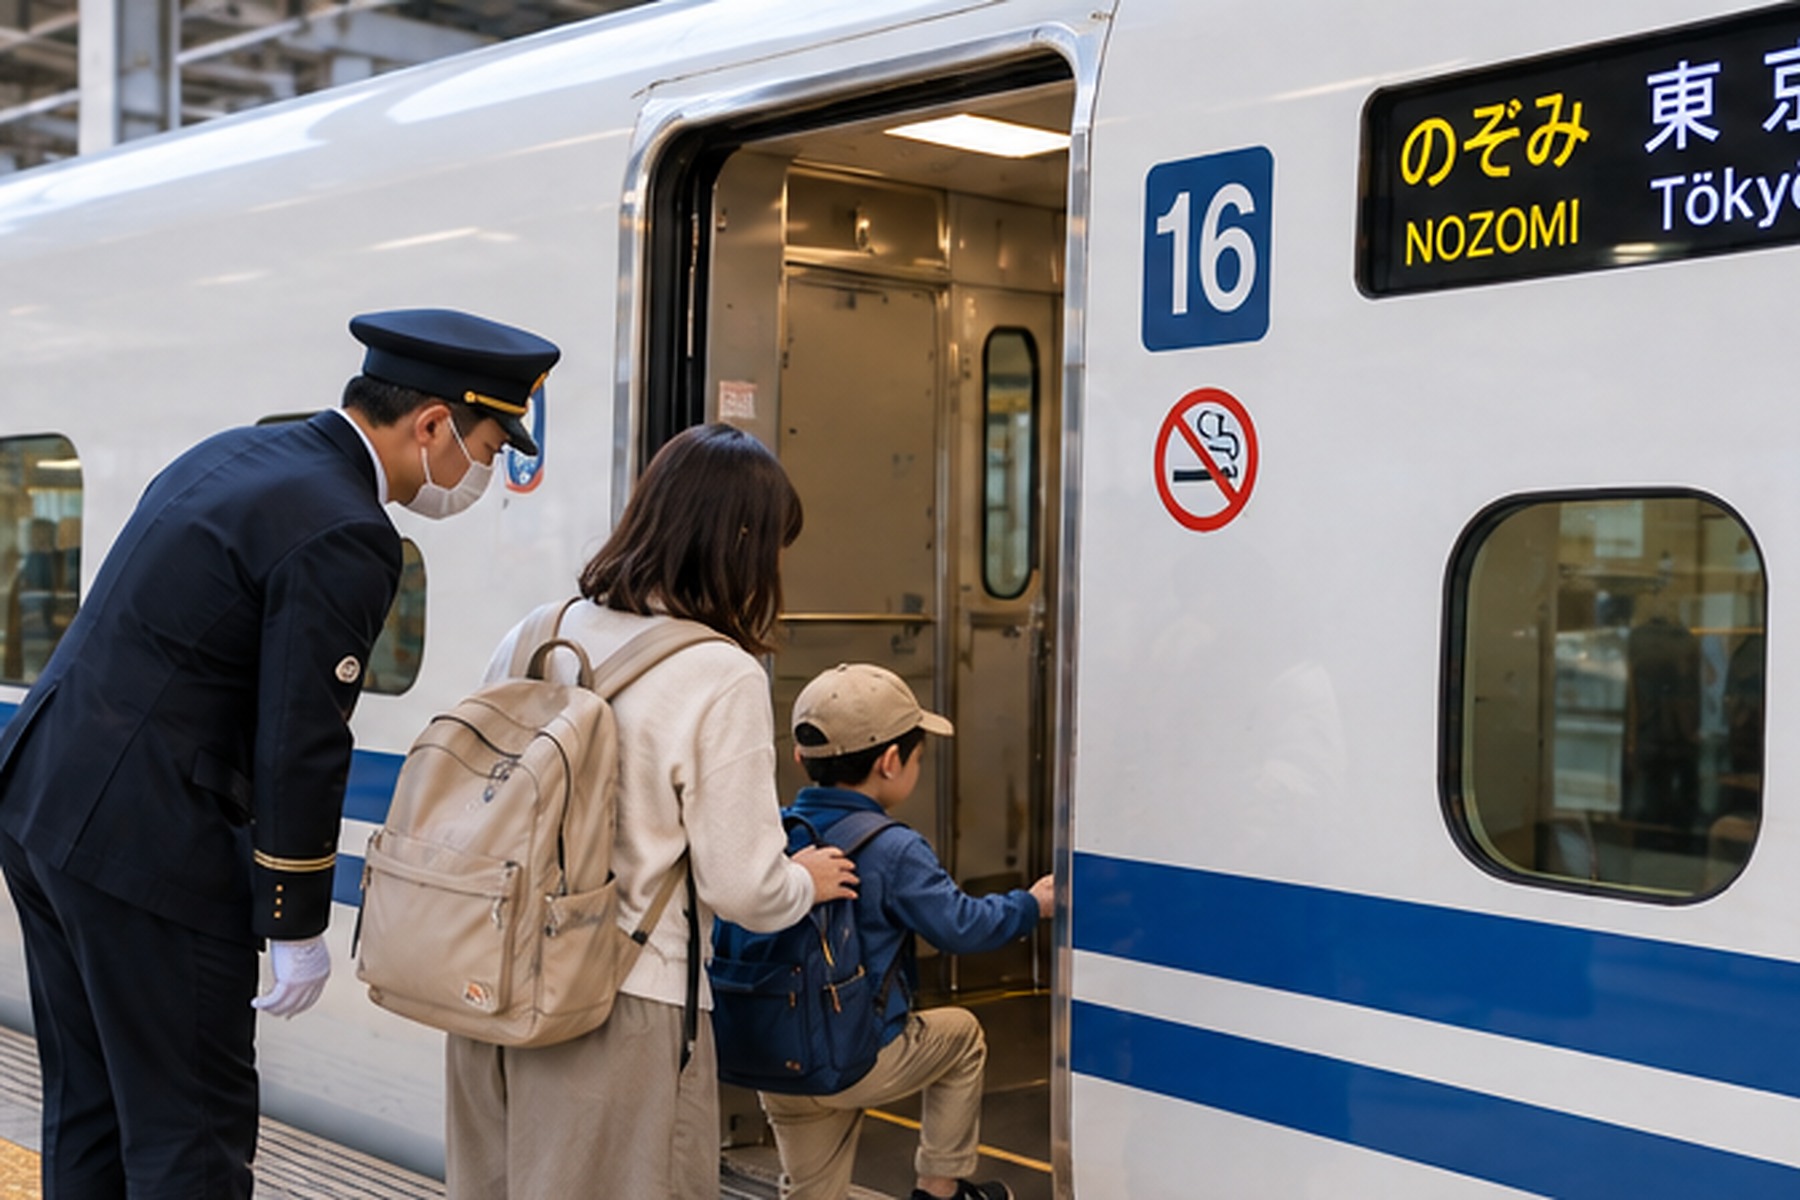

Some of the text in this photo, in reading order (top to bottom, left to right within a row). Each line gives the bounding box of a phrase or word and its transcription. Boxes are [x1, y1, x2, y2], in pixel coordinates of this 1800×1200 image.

[1401, 93, 1590, 187] のぞみ
[1156, 183, 1256, 315] 16
[1406, 199, 1580, 266] NOZOMI
